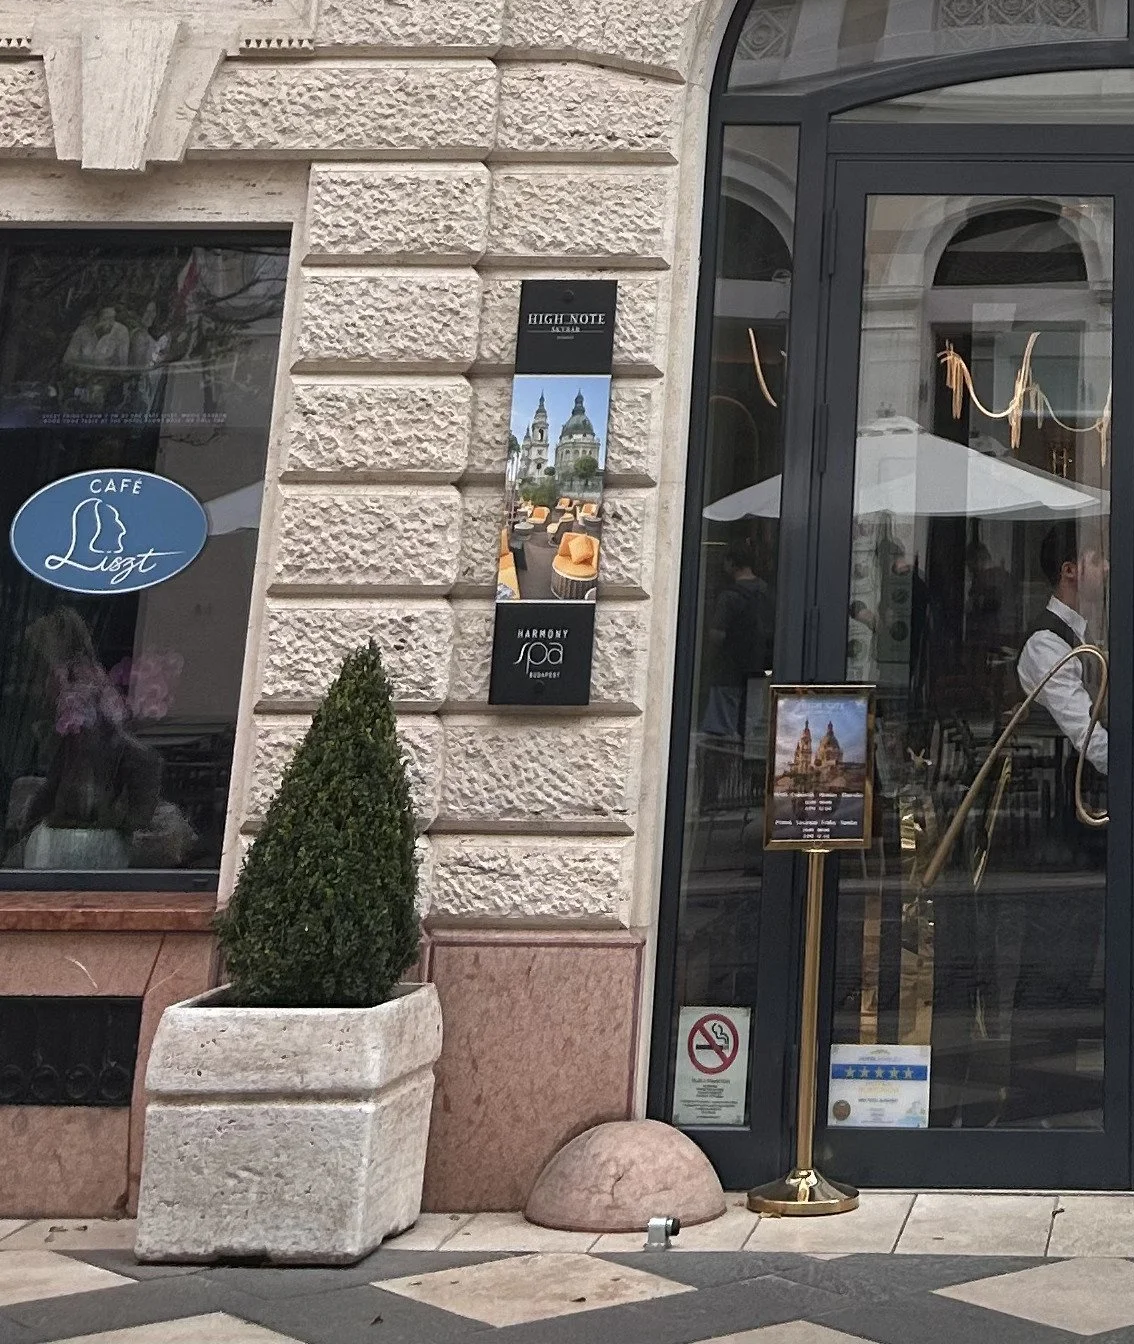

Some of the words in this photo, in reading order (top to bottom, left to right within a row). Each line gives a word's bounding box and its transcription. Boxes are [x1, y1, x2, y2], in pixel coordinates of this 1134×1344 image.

[528, 313, 564, 325] HIGH
[569, 313, 606, 325] NOTE
[89, 477, 143, 495] CAFÉ
[44, 497, 186, 585] Liszt
[517, 628, 569, 640] HARMONY
[513, 641, 564, 675] spa
